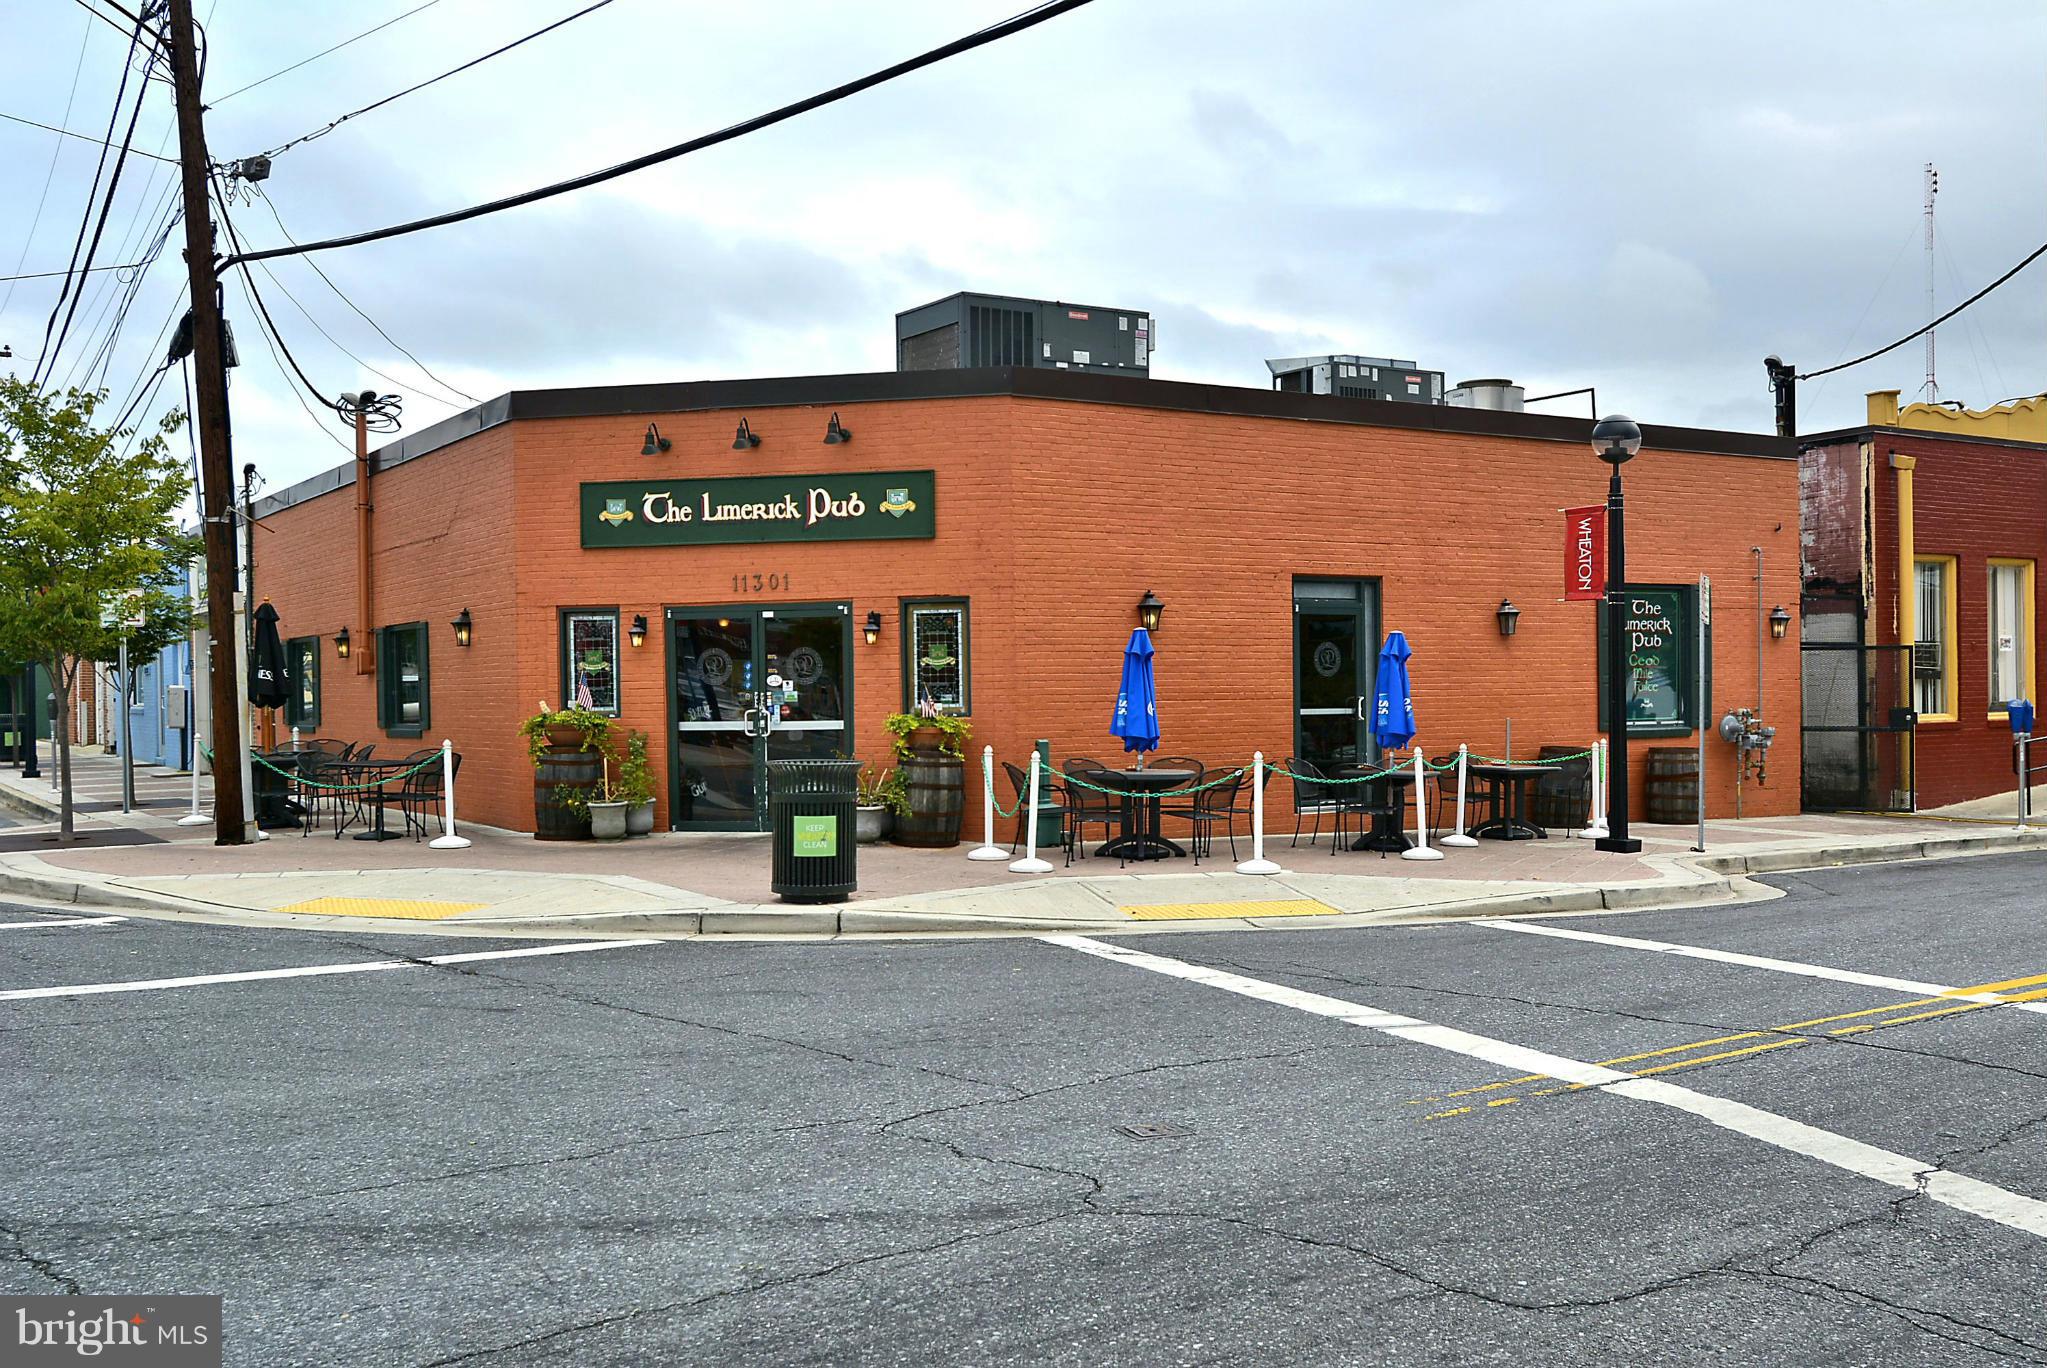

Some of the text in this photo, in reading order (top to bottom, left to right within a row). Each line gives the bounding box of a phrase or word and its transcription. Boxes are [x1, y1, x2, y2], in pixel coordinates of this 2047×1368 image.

[641, 488, 866, 528] The Limerick Pub
[1578, 517, 1592, 590] WHEATON
[732, 573, 790, 592] 11301
[1632, 599, 1662, 615] The
[1624, 617, 1673, 635] imerick
[1632, 632, 1662, 652] Pub
[1633, 667, 1654, 679] Mile
[805, 824, 825, 832] KEEP
